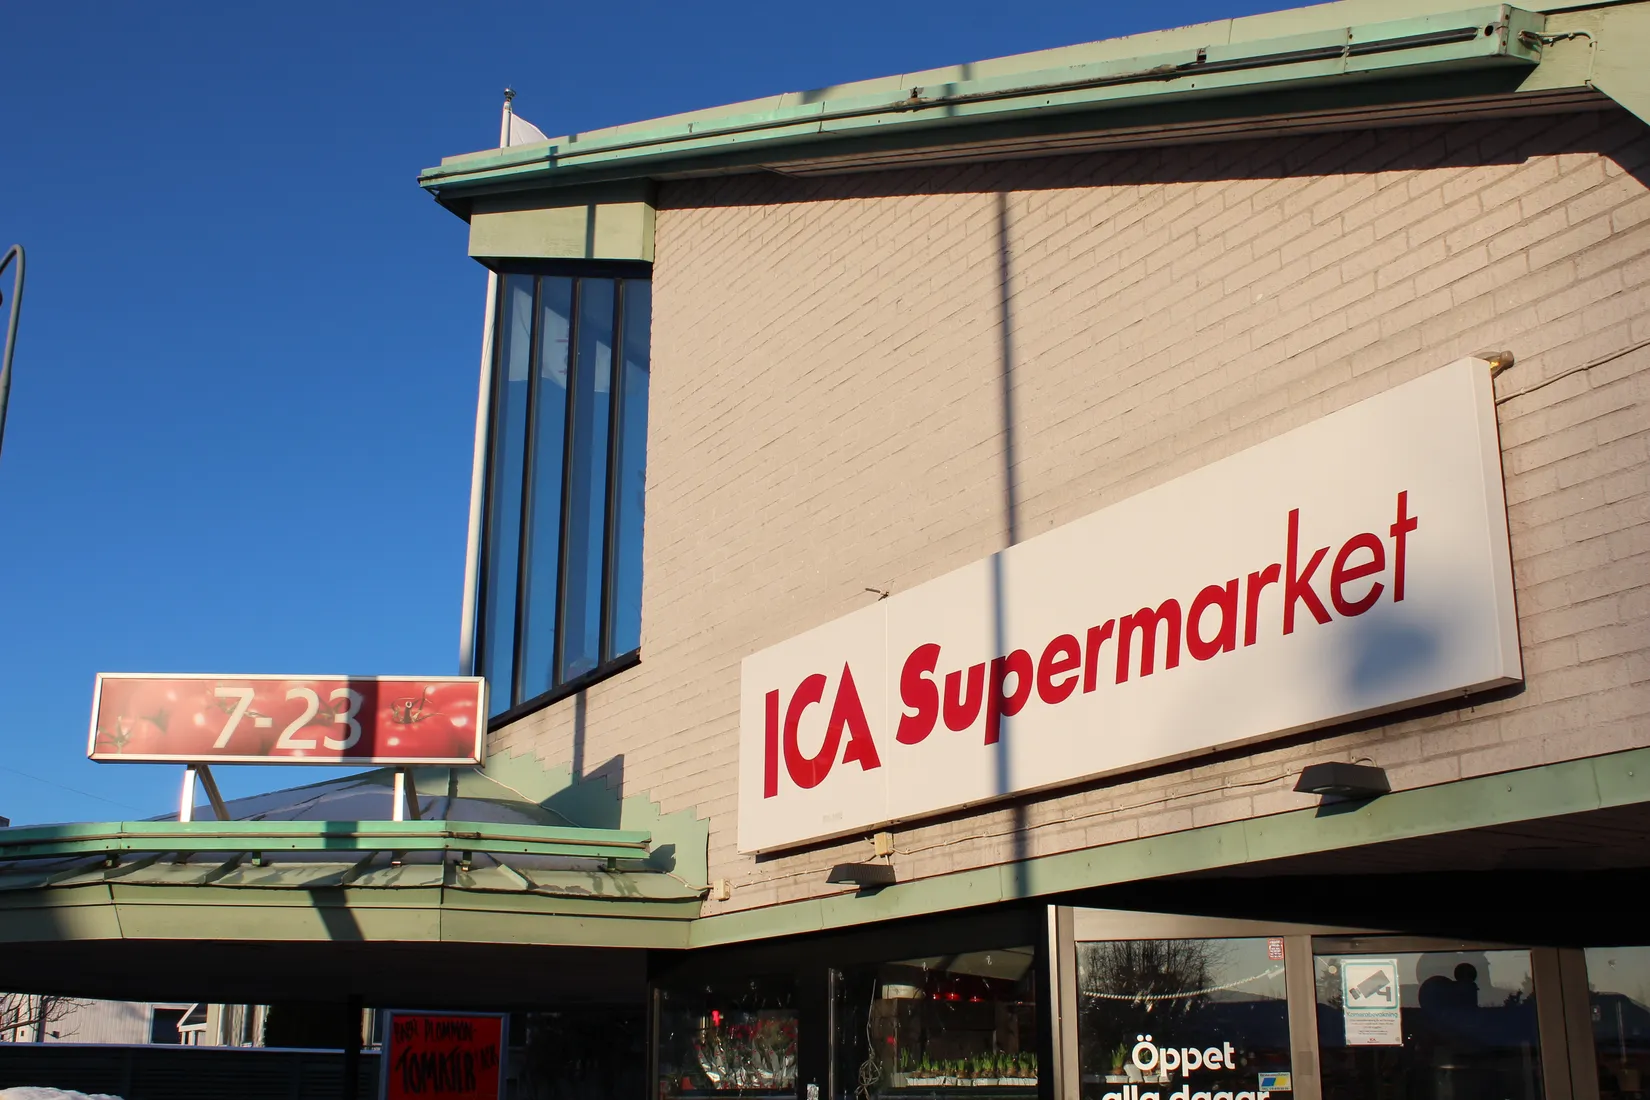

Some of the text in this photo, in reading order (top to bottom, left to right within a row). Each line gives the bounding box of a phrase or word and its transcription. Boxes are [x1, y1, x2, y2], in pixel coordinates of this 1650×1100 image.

[764, 490, 1418, 799] ICA Supermarket
[212, 687, 363, 751] 7-23
[1131, 1034, 1236, 1078] Öppet
